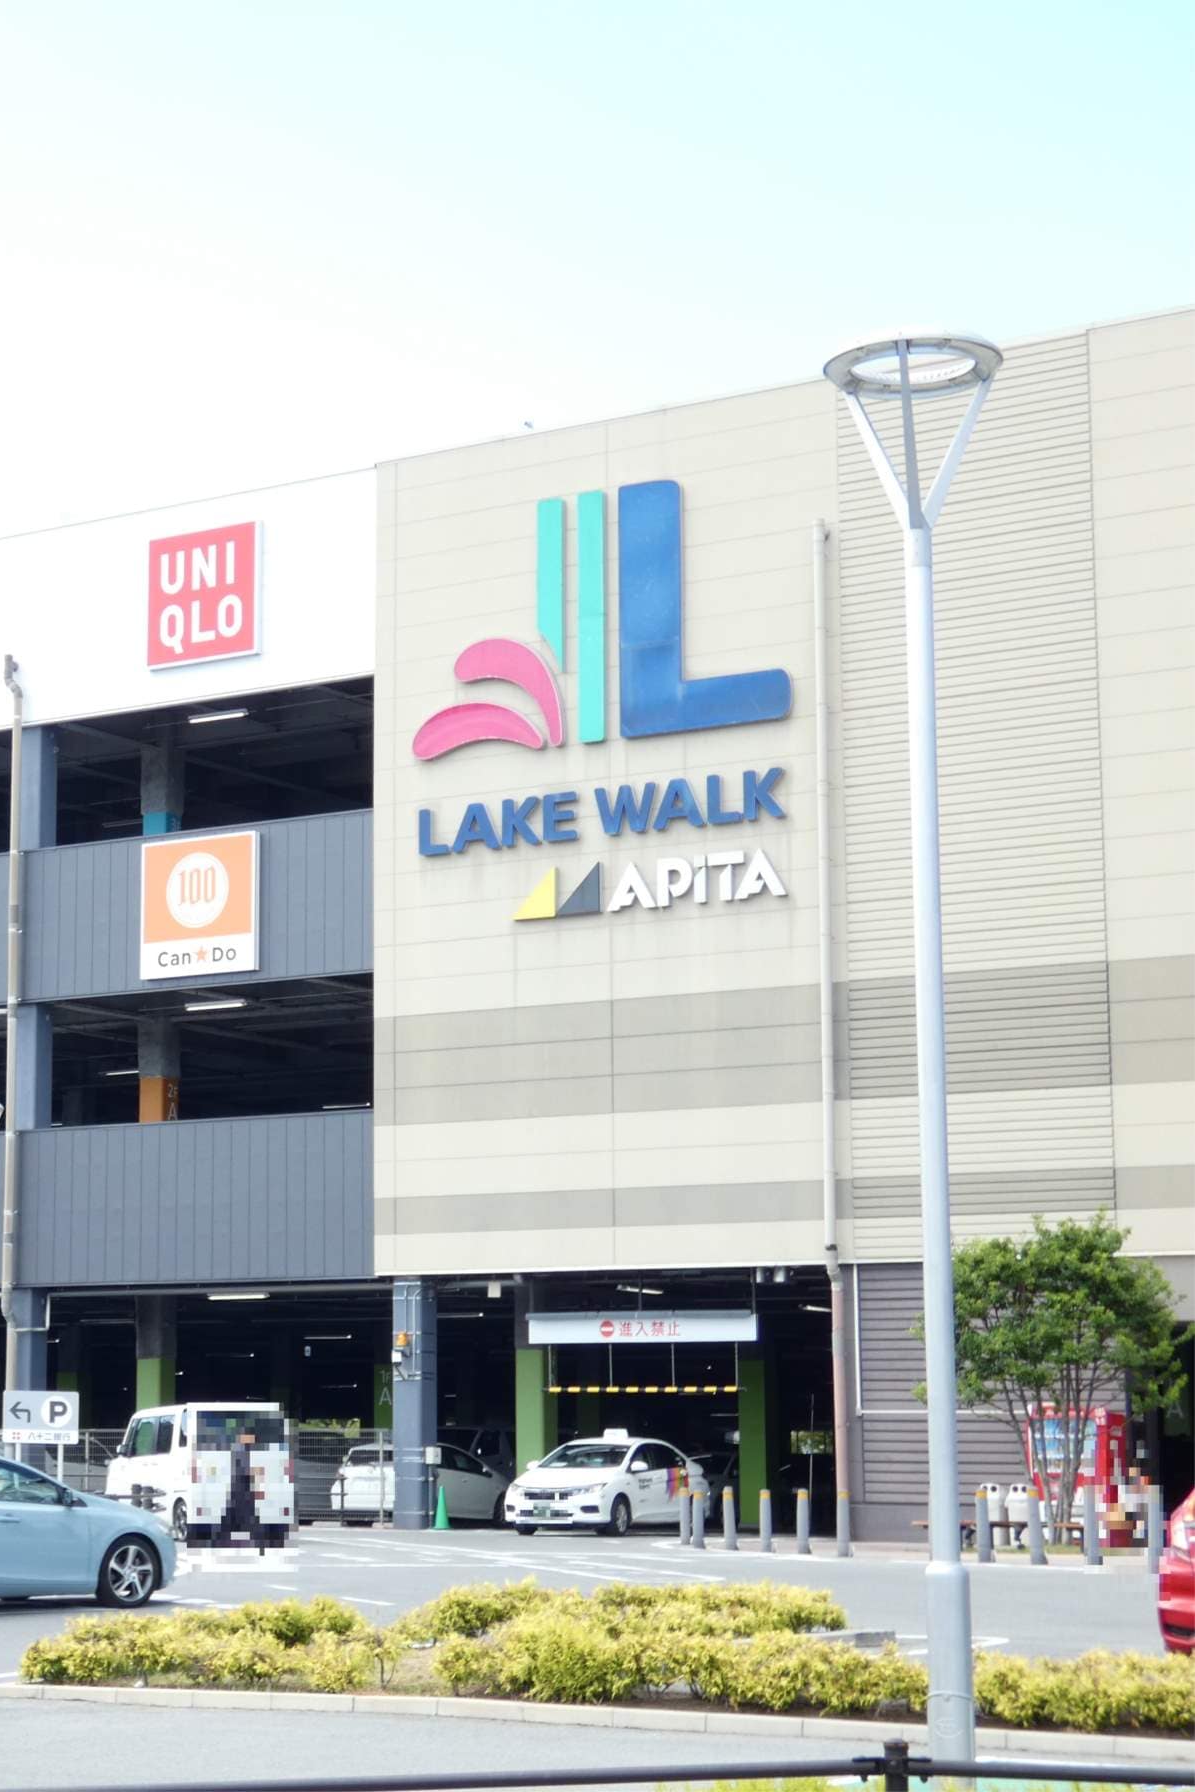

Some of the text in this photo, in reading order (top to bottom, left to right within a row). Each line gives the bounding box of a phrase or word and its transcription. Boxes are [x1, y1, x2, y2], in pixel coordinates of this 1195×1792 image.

[160, 540, 235, 595] UNI
[159, 593, 243, 655] QLO
[419, 767, 787, 856] LAKE WALK
[178, 866, 216, 906] 100
[618, 1320, 680, 1337] 進入禁止
[49, 1400, 68, 1423] P
